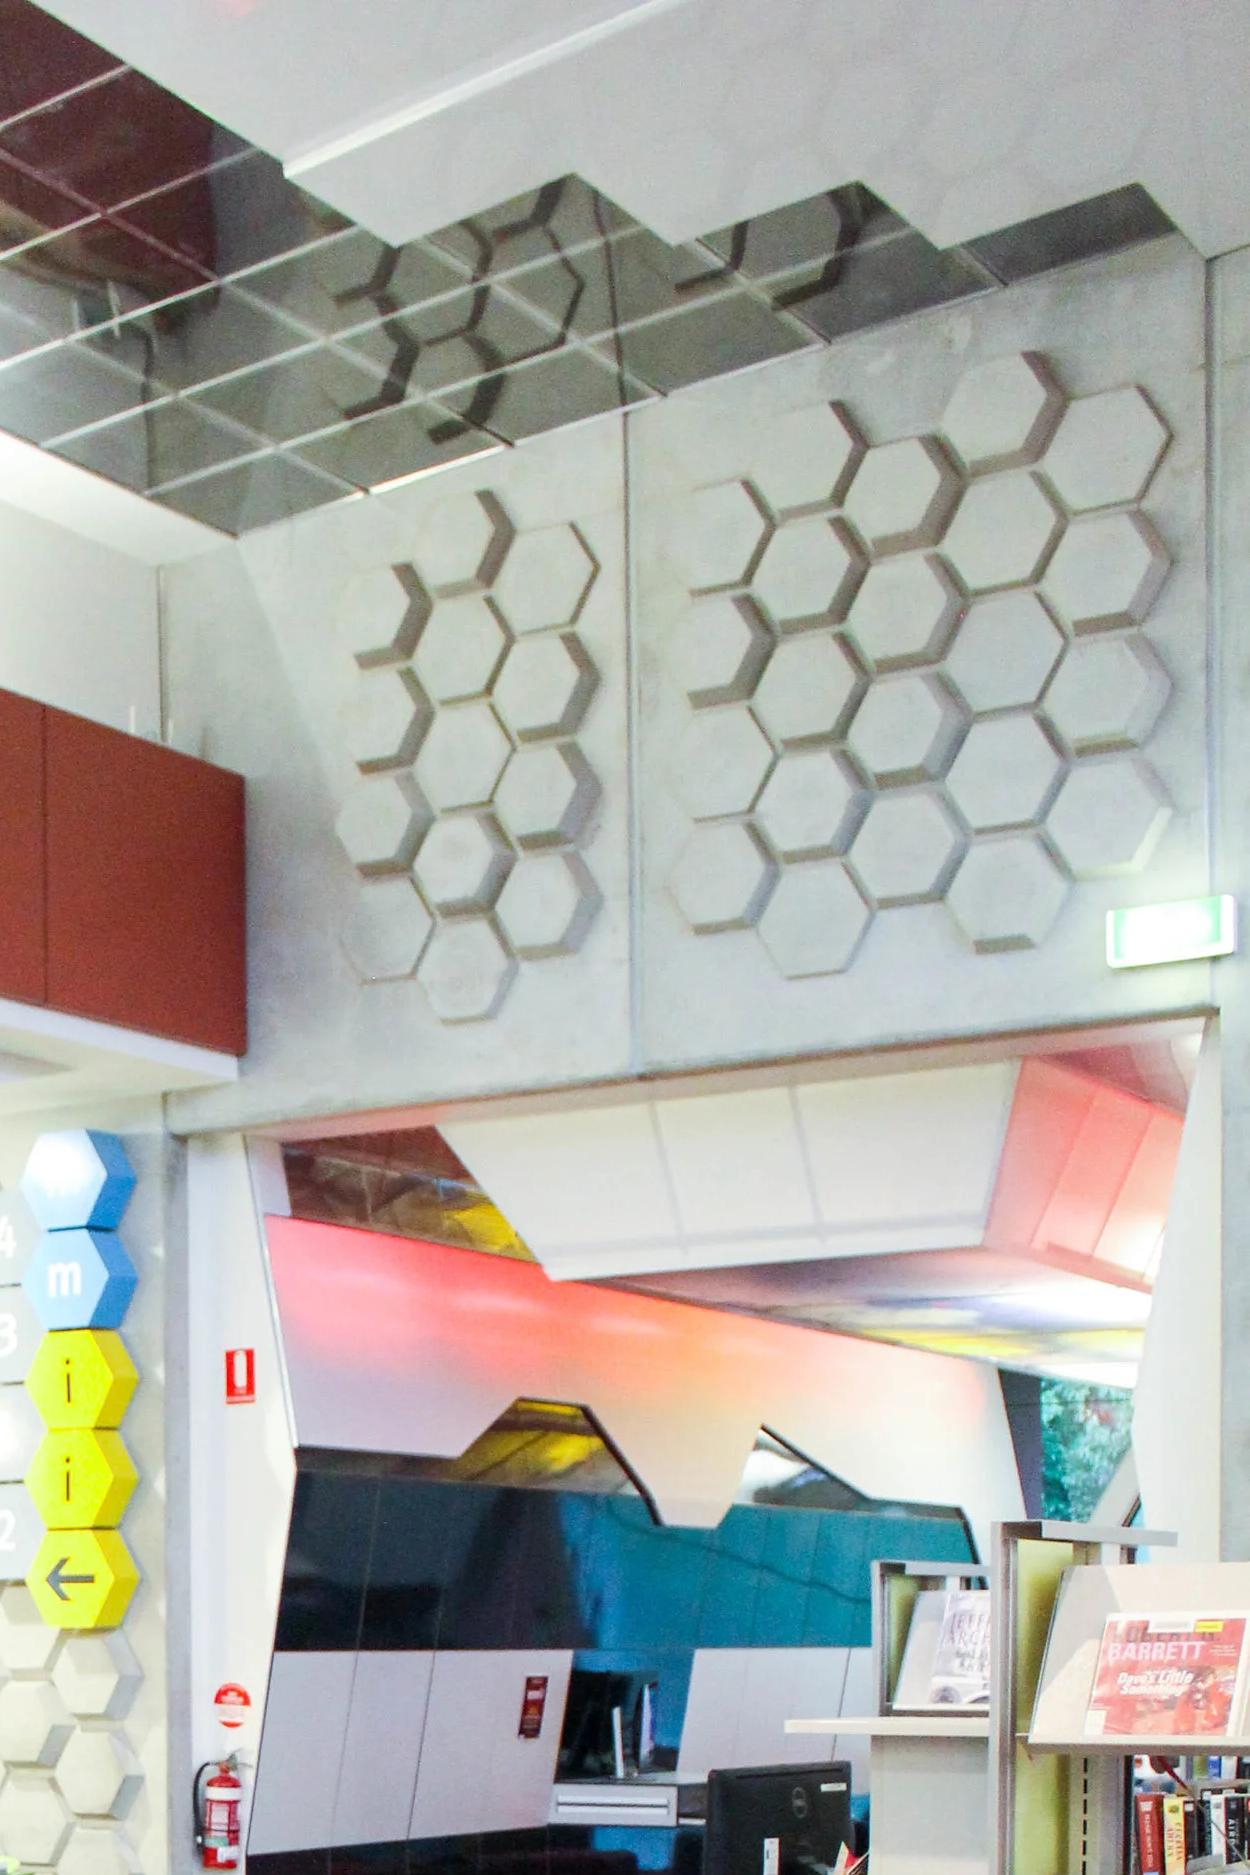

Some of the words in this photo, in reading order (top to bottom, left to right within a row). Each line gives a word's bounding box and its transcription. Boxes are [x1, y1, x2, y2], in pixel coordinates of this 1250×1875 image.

[47, 1261, 82, 1298] m
[63, 1358, 72, 1404] i
[63, 1455, 72, 1502] i
[1107, 1641, 1205, 1661] BARRETT
[1158, 1669, 1195, 1685] Little
[1119, 1684, 1187, 1699] Something
